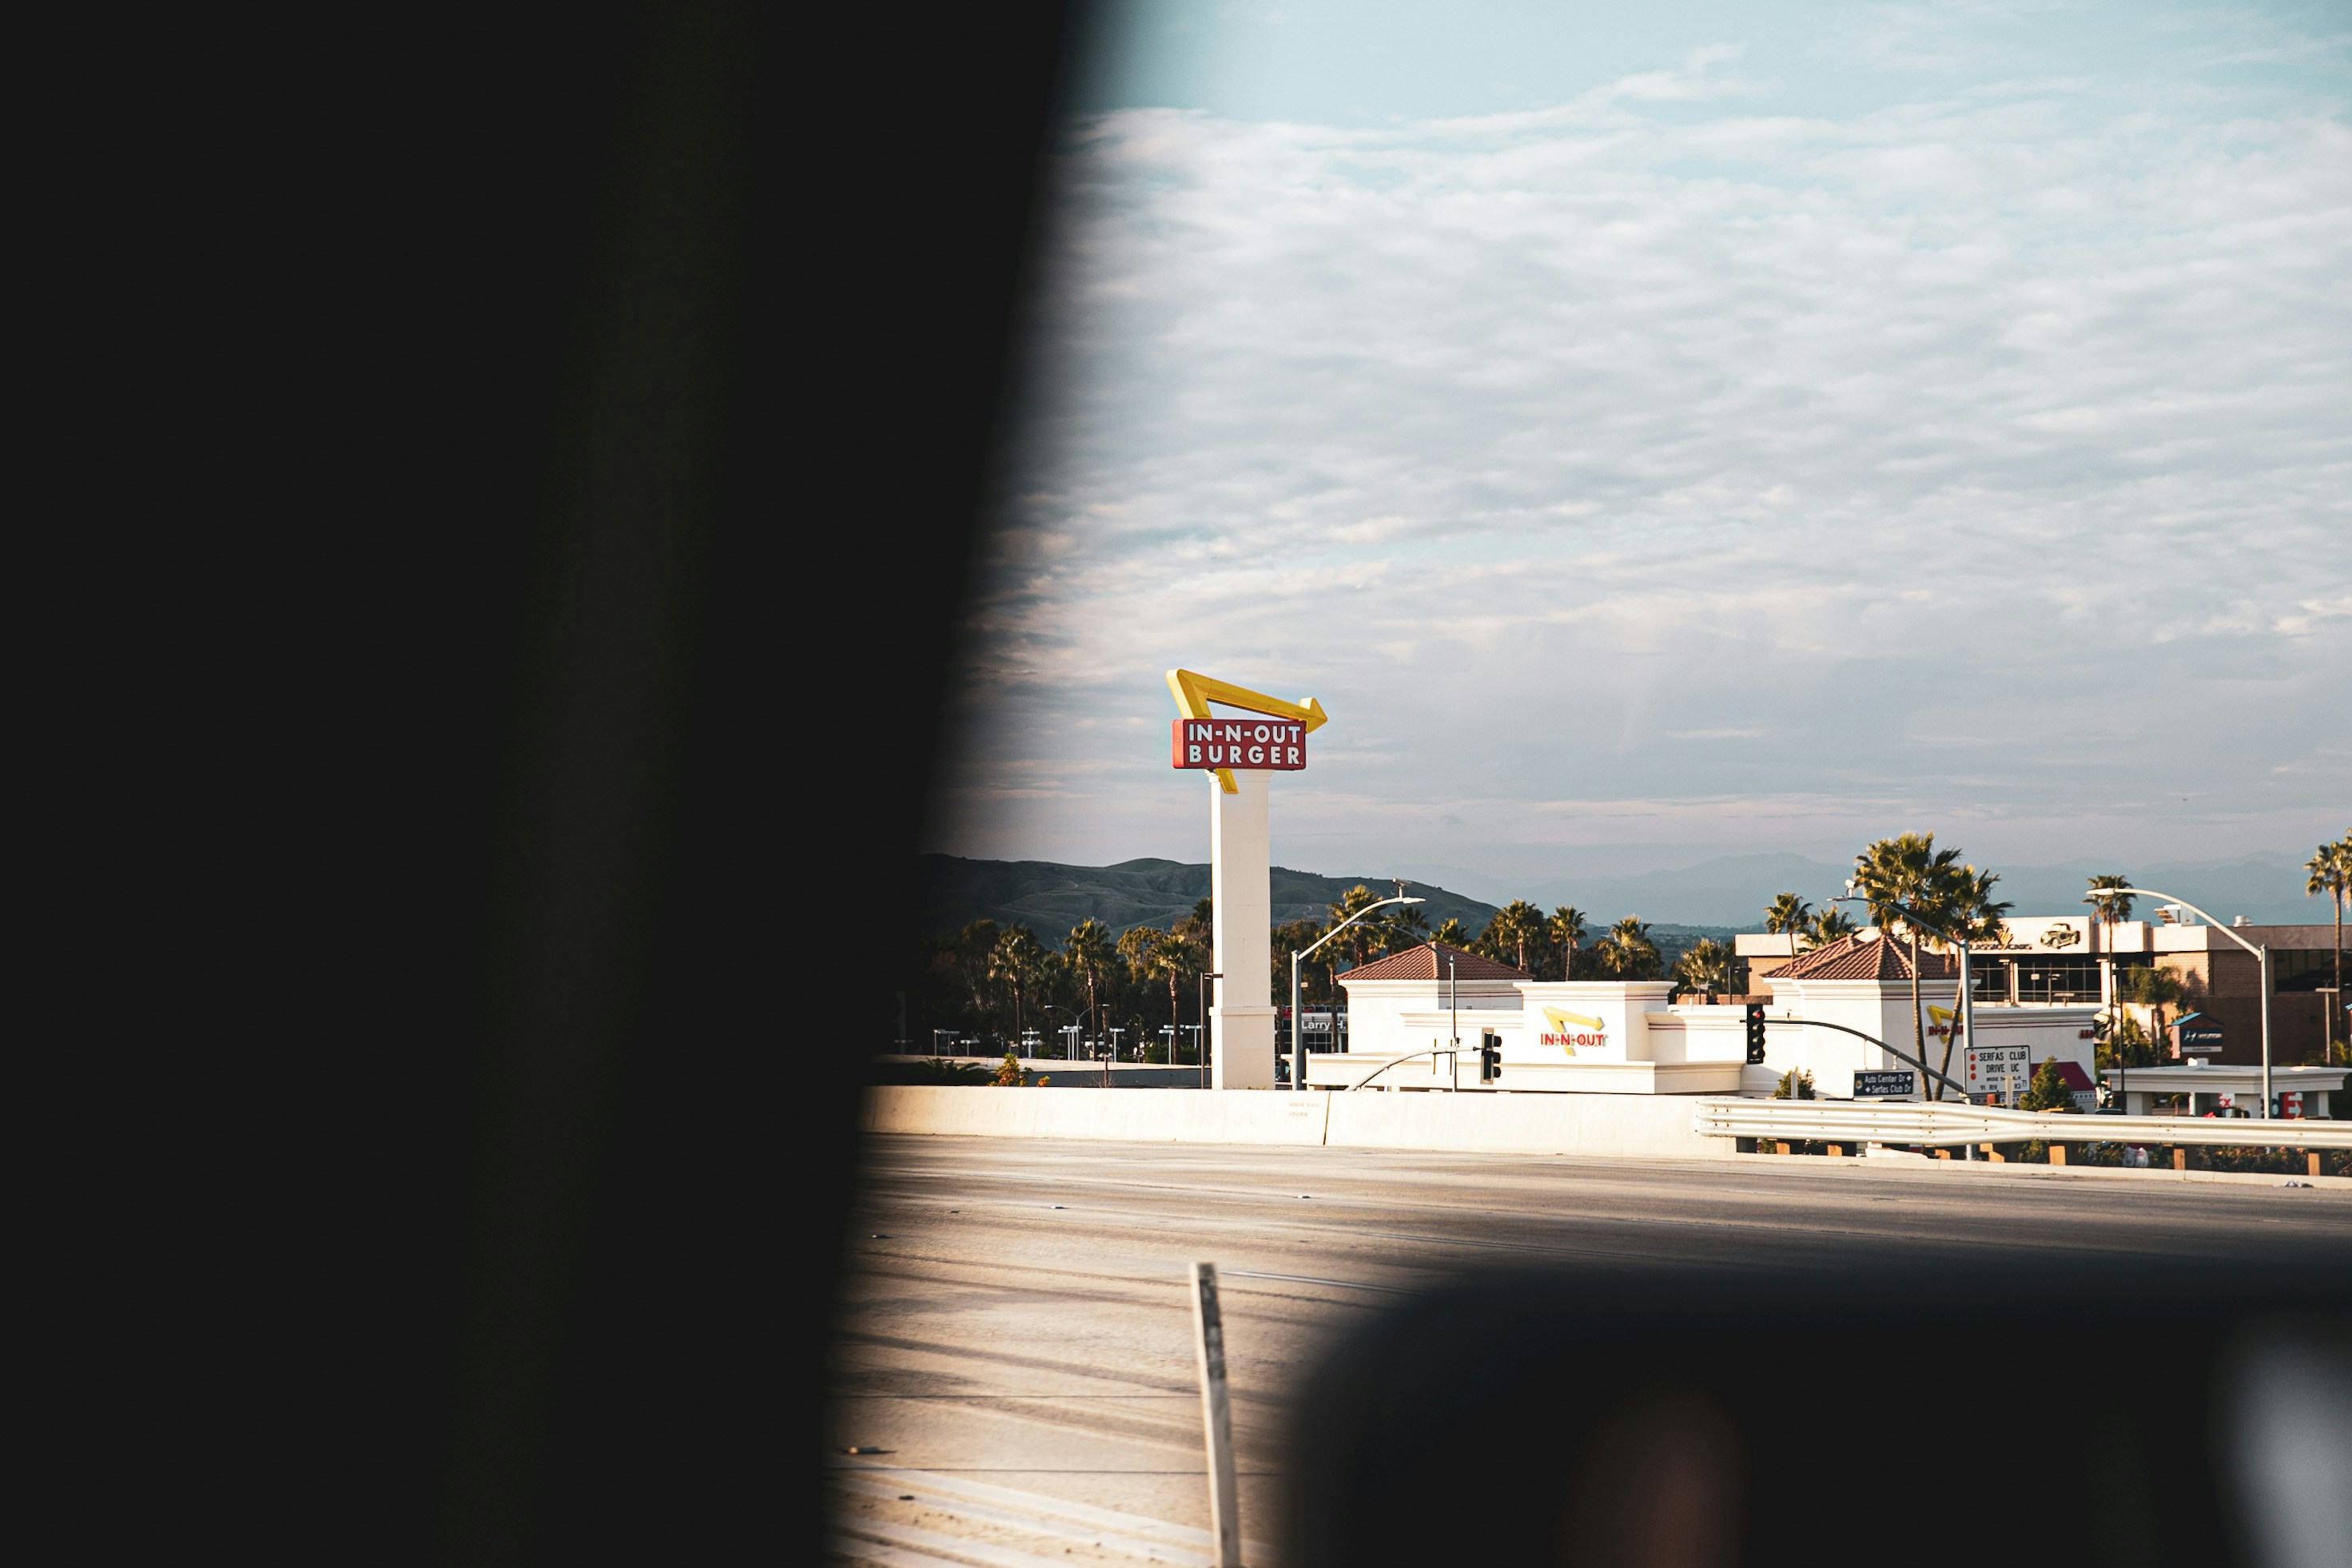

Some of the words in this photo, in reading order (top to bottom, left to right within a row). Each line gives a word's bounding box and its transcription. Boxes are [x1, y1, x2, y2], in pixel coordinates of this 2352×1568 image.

[1188, 723, 1301, 743] IN-N-OUT
[1188, 744, 1300, 765] BURGER
[1301, 1020, 1331, 1031] Larry
[1540, 1033, 1604, 1046] IN-N-OUT
[1979, 1052, 2004, 1061] SERFAS
[2009, 1051, 2026, 1061] CLUB
[1986, 1064, 2005, 1073] DRIVE
[2011, 1063, 2020, 1072] UC
